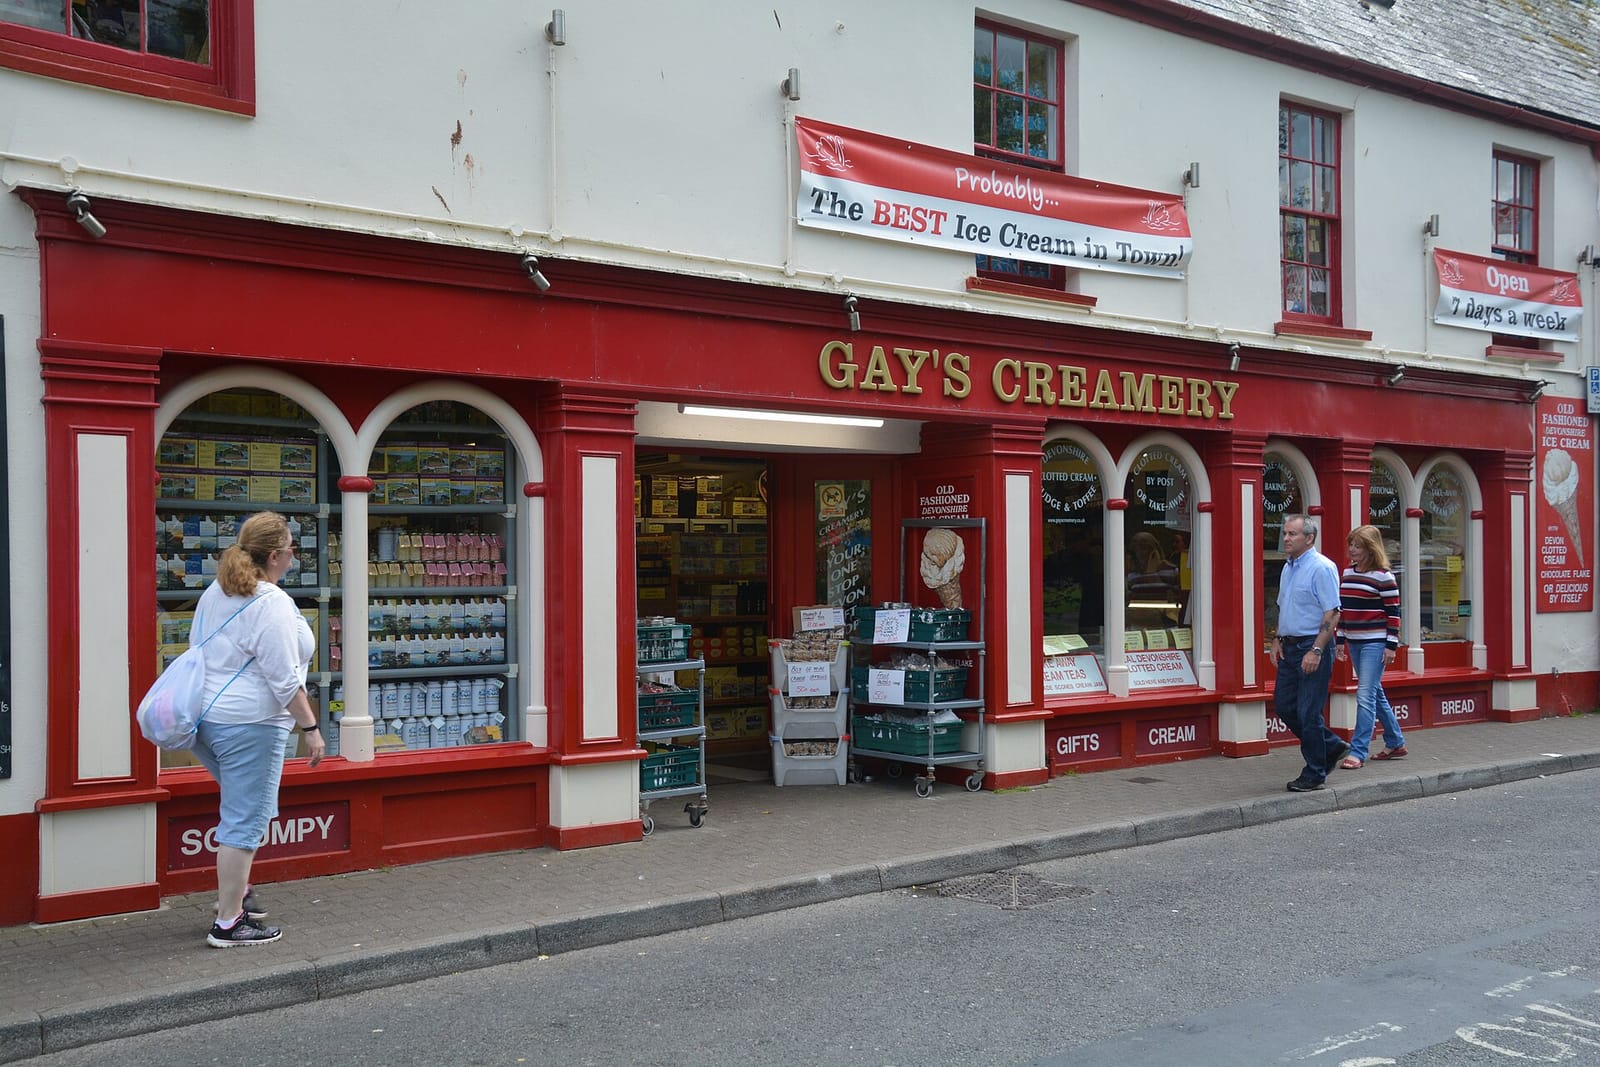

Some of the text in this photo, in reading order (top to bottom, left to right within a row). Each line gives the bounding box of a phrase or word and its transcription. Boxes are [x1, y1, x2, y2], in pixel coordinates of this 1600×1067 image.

[955, 167, 1060, 211] Probably...
[810, 186, 1184, 268] The BEST Ice Cream in Town!
[1486, 265, 1530, 295] Open
[1452, 295, 1568, 331] 7 days a week
[818, 340, 1240, 419] GAY'S CREAMERY
[1557, 403, 1575, 414] OLD
[1542, 413, 1589, 428] FASHIONED
[1542, 436, 1591, 449] ICE CREAM
[1042, 471, 1094, 482] LOTTED CREAM
[1146, 476, 1175, 487] BY POST
[936, 485, 954, 495] OLD
[1264, 482, 1287, 492] BAKING
[920, 494, 970, 506] FASHIONED
[1041, 484, 1097, 512] UDGE & TOFFEE
[1136, 488, 1185, 512] OR TAKE-AWAY
[1278, 495, 1294, 512] DAILY
[921, 504, 968, 515] DEVONSHIRE
[1544, 536, 1565, 545] DEVON
[1541, 546, 1567, 555] CLOTTED
[1543, 555, 1566, 565] CREAM
[831, 560, 857, 582] ONE
[1540, 570, 1591, 579] CHOCOLATE FLAKE
[1543, 583, 1589, 593] OR DELICIOUS
[1549, 594, 1583, 604] BY ITSELF
[1136, 652, 1182, 663] DEVONSHIRE
[1127, 662, 1184, 673] LOTTED CREAM
[1064, 668, 1087, 681] TEAS
[1441, 699, 1475, 715] BREAD
[1148, 725, 1196, 746] CREAM
[1056, 733, 1100, 755] GIFTS
[181, 815, 335, 856] SCUMPY
